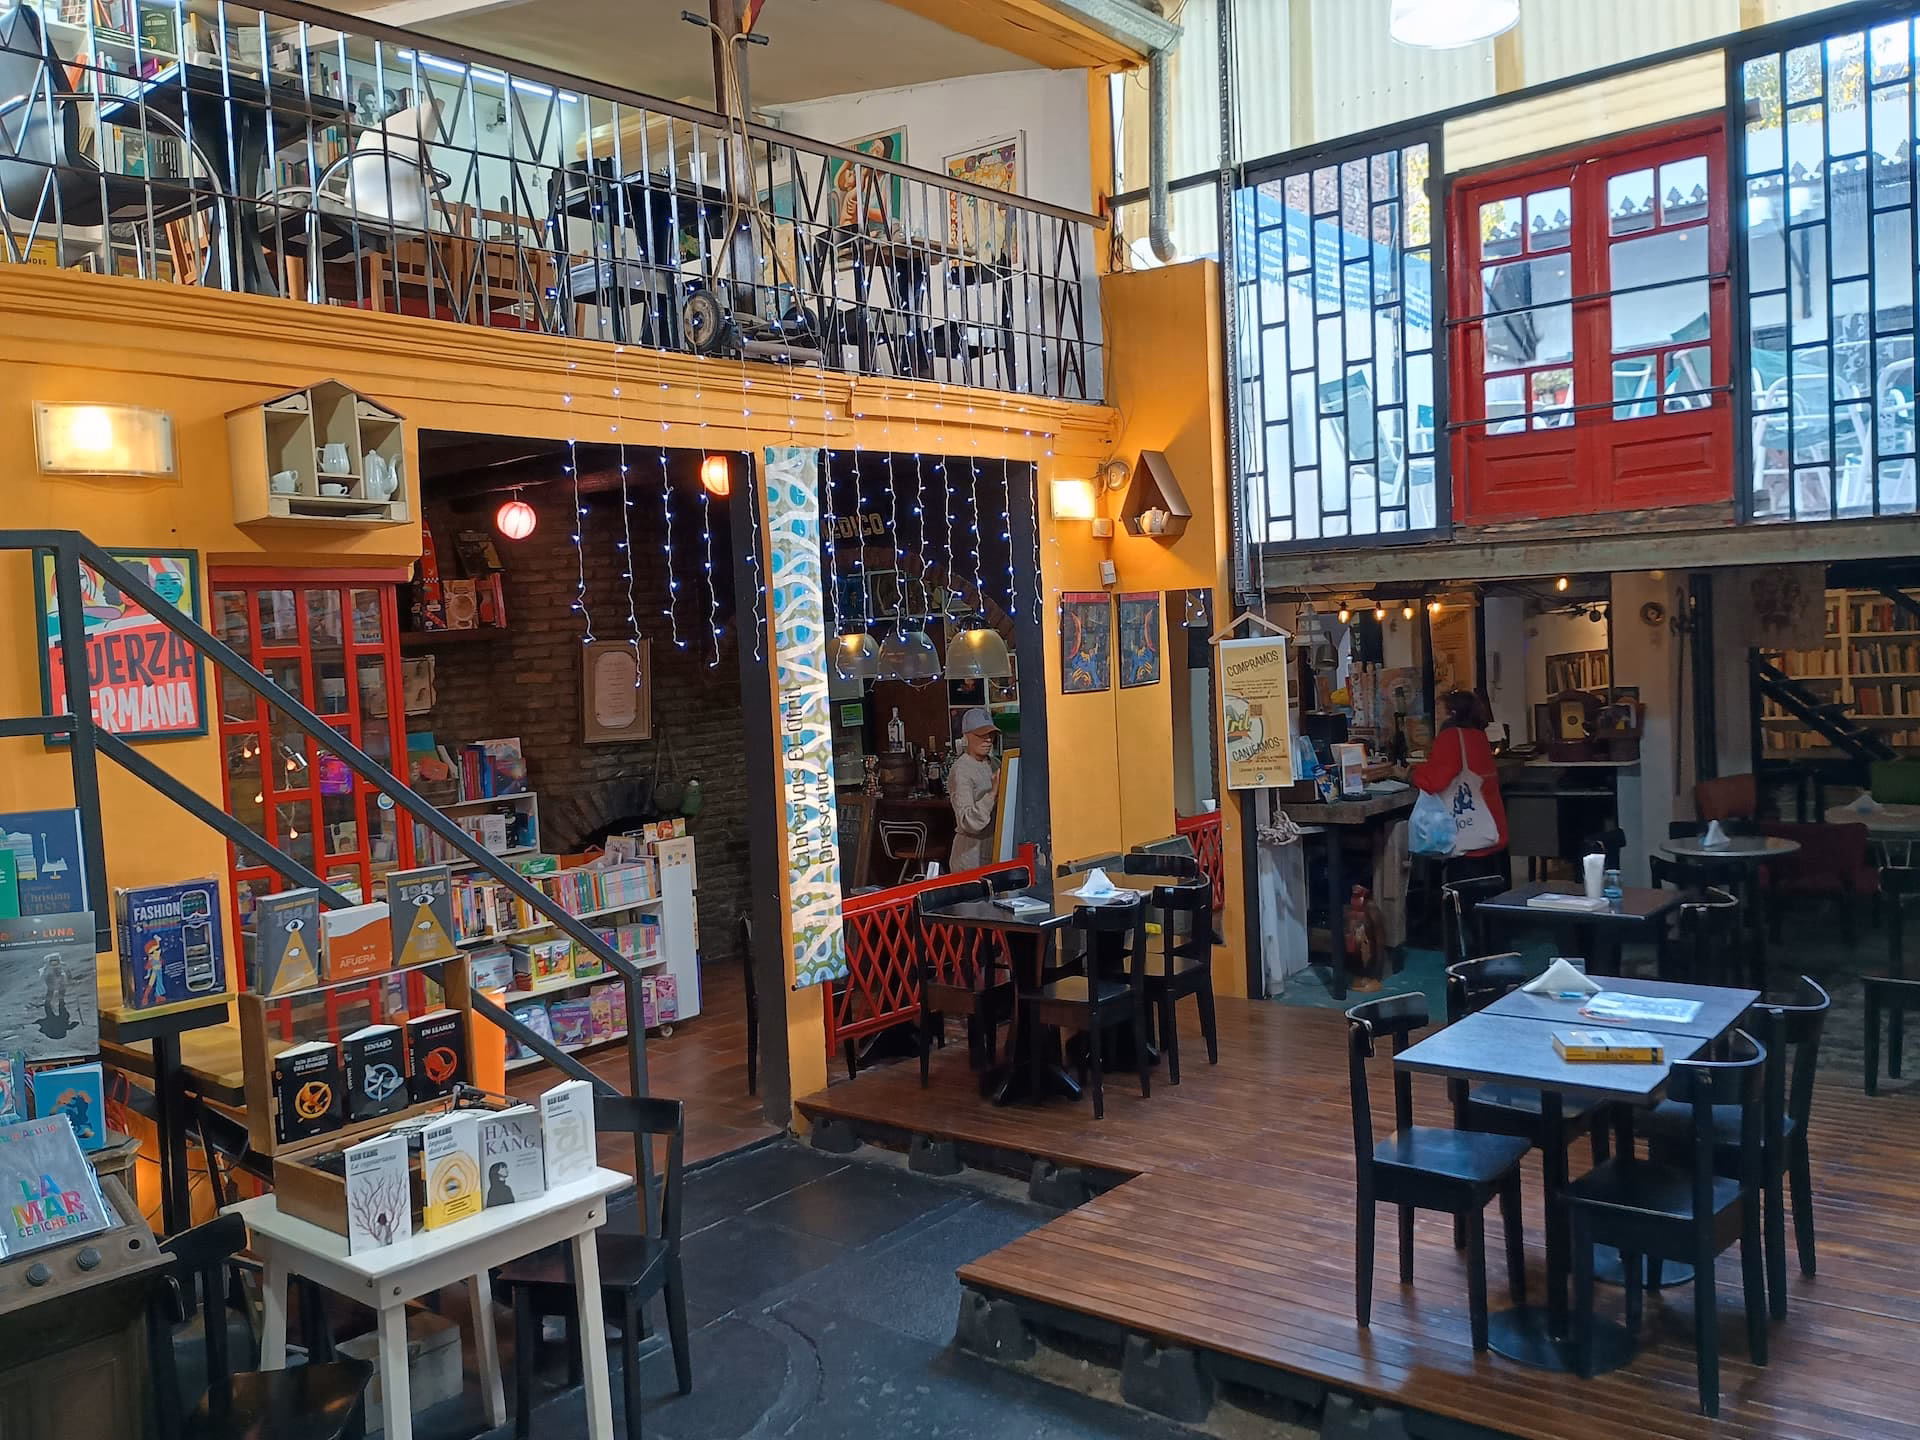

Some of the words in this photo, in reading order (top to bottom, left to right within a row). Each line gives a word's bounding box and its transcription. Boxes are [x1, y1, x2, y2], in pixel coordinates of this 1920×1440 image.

[54, 631, 193, 687] UERZA
[1226, 650, 1279, 677] COMPRAMOS
[61, 682, 196, 733] RMANA
[817, 771, 836, 865] presenta
[400, 880, 446, 901] 1984
[133, 901, 181, 921] FASHION
[42, 927, 75, 938] LUNA
[339, 953, 376, 969] AFUERA
[485, 1121, 522, 1141] HAN
[486, 1135, 536, 1157] KANG
[20, 1173, 61, 1201] LA
[11, 1190, 85, 1228] MAR
